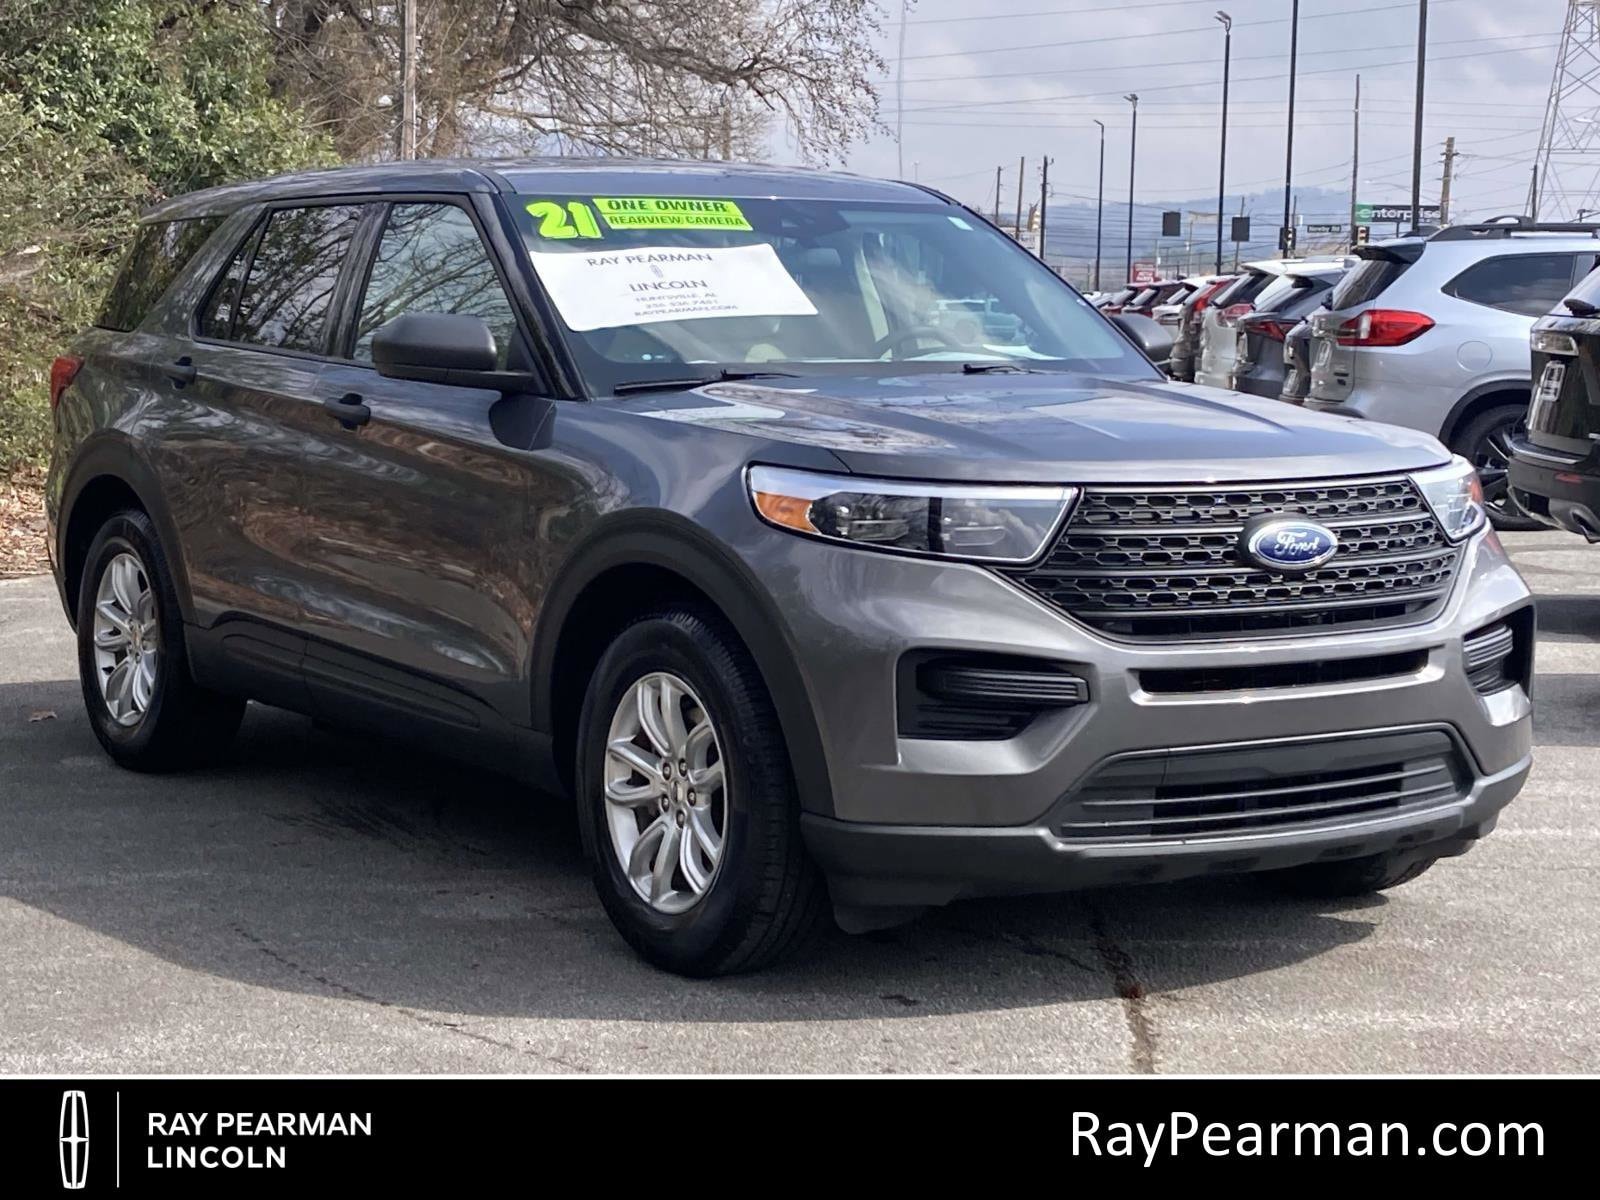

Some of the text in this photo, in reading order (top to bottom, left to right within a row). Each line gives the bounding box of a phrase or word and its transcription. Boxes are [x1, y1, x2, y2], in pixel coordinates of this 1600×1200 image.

[607, 199, 728, 212] ONE OWNER
[526, 201, 603, 239] 21
[1356, 207, 1441, 220] enterpise
[609, 215, 745, 226] REARVIEW CAMERA
[586, 253, 713, 266] RAY PEARMAN
[629, 280, 709, 292] LINCOLN
[1274, 531, 1321, 556] Ford
